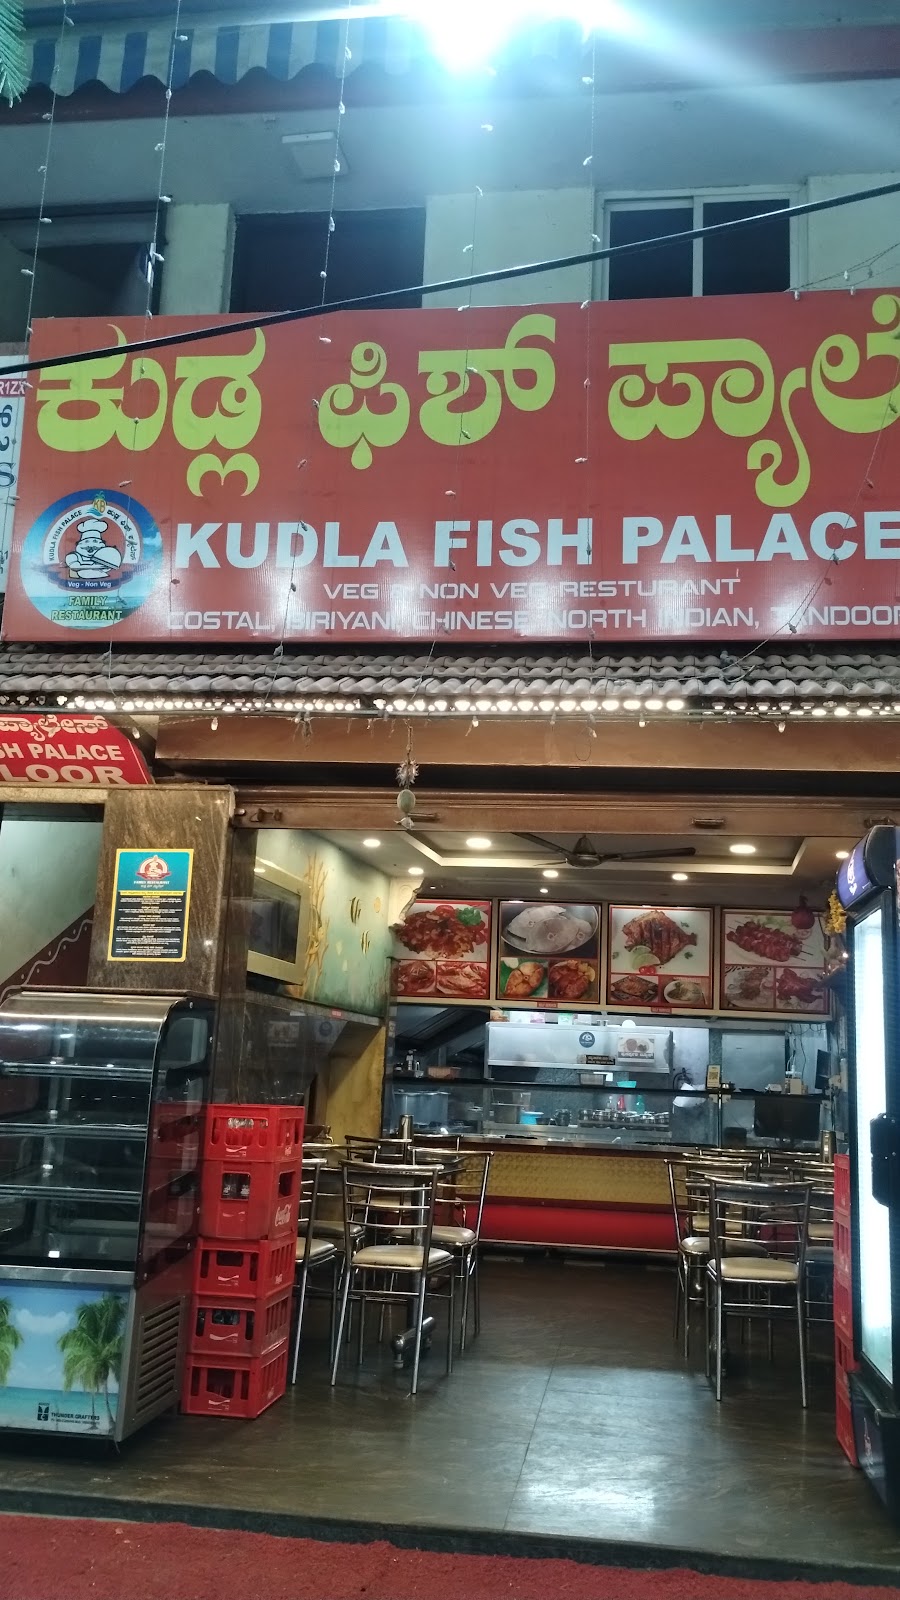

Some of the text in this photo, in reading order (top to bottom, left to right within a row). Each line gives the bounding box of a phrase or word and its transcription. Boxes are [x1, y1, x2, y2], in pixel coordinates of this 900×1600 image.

[318, 313, 556, 470] ಫಿಶ್
[49, 509, 83, 562] KUDLA FISH PALACE
[175, 511, 900, 569] KUDLA FISH PALACE
[68, 581, 80, 589] Veg
[100, 581, 112, 589] Veg
[323, 583, 379, 599] VEG
[420, 583, 479, 599] NON
[490, 582, 547, 599] VEG
[559, 579, 741, 598] RESTURANT
[68, 595, 109, 607] FAMILY
[51, 610, 123, 620] RESTAURANT
[167, 611, 276, 632] COSTAL,
[549, 608, 647, 629] NORTH
[659, 607, 760, 630] INDIAN,
[27, 743, 125, 761] PALACE
